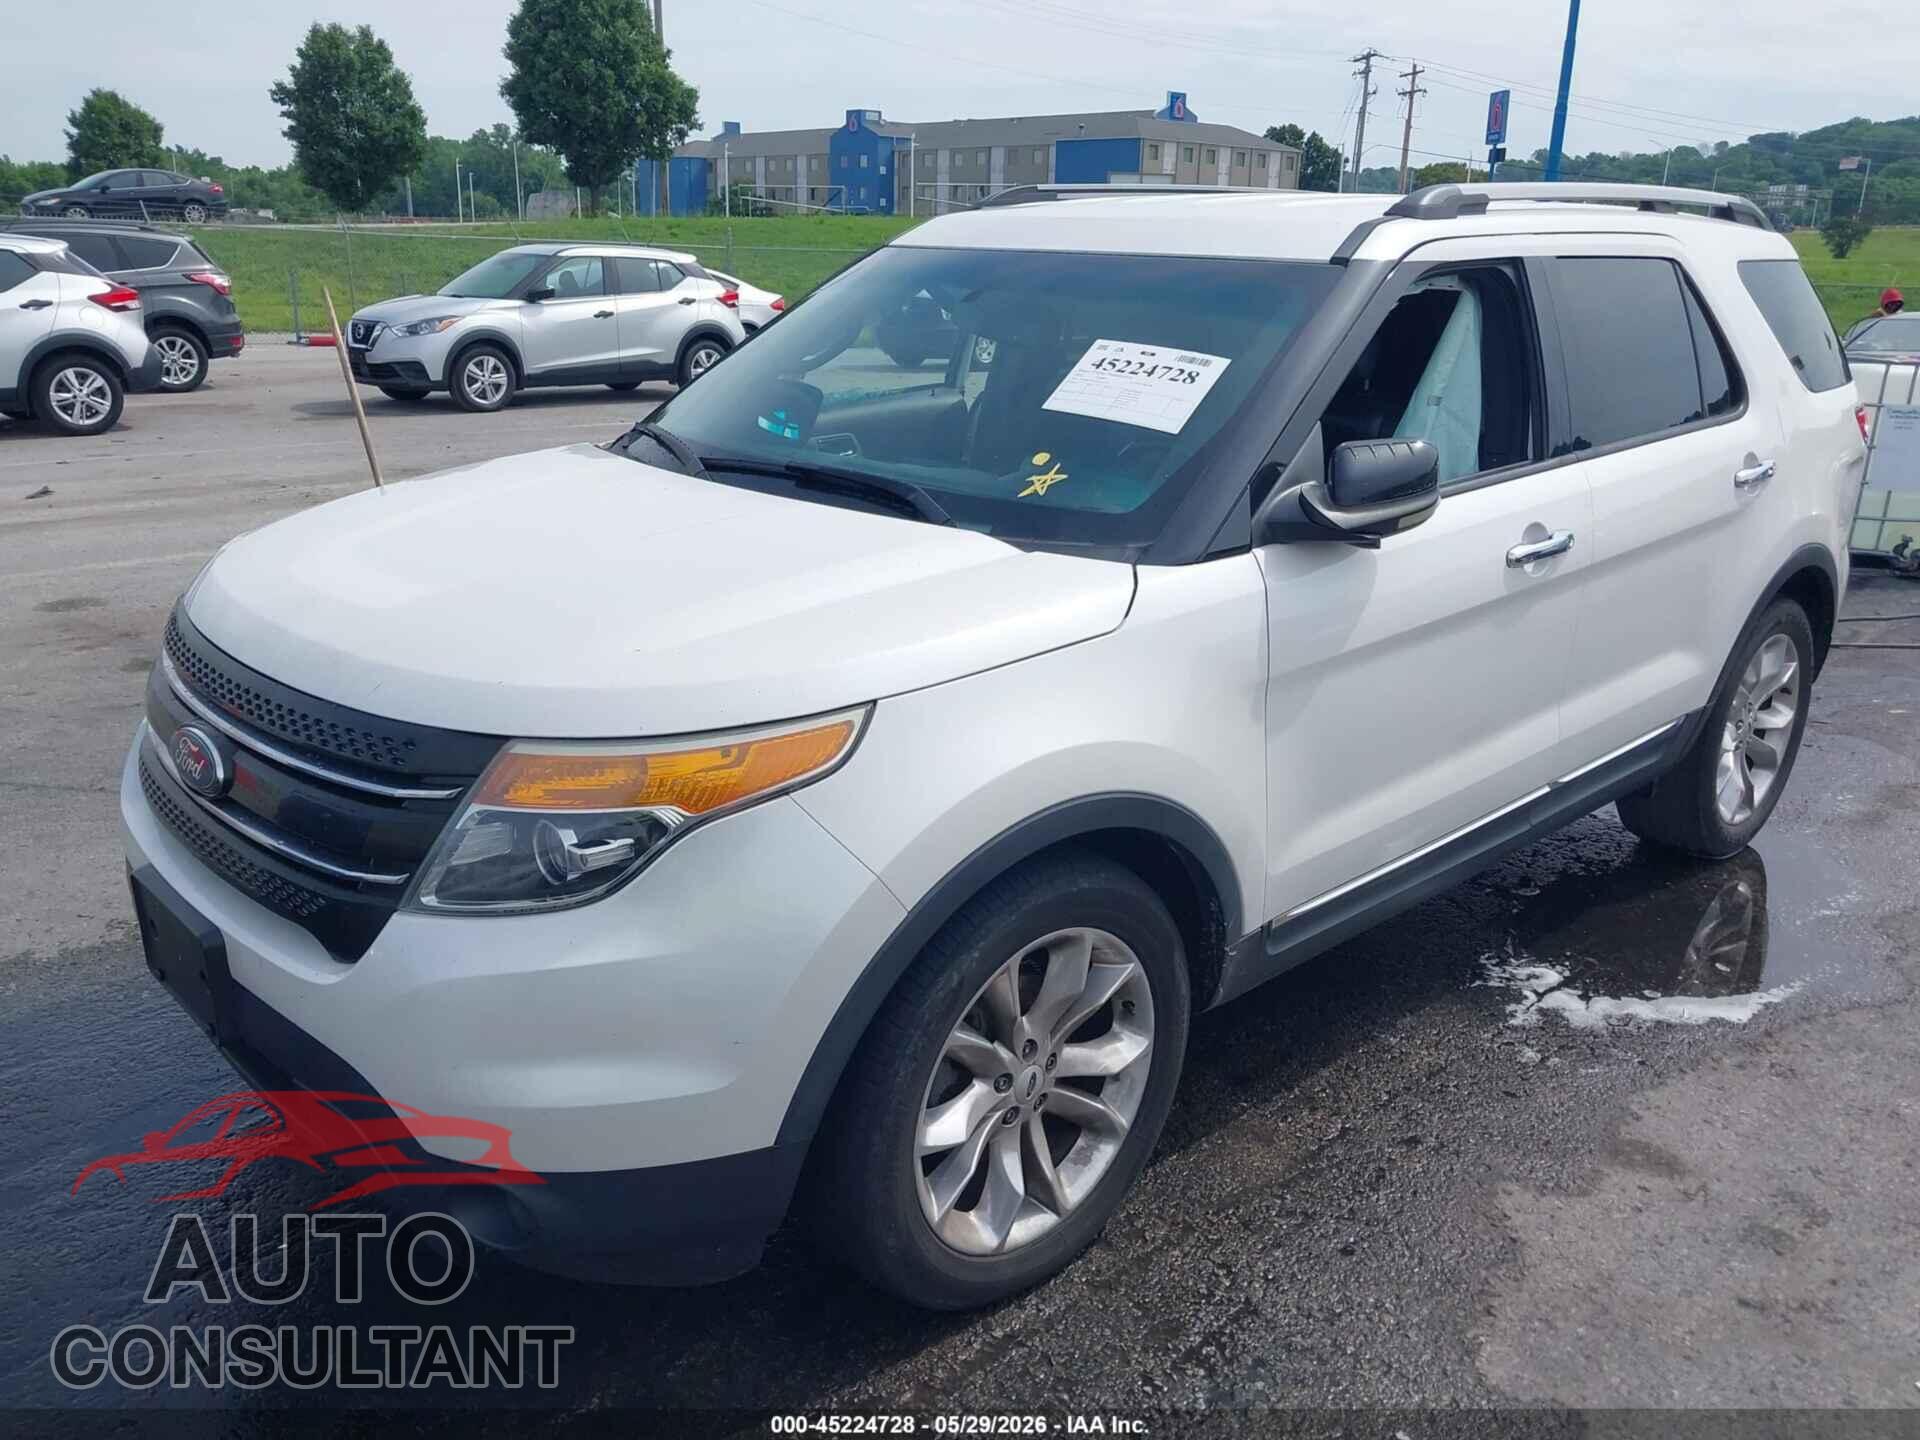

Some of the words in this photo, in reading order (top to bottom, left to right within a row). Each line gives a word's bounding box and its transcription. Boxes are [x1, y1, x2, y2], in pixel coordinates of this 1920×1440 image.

[1174, 96, 1184, 118] 6
[848, 112, 858, 132] 6
[1091, 357, 1200, 384] 45224728
[179, 736, 205, 780] Ford
